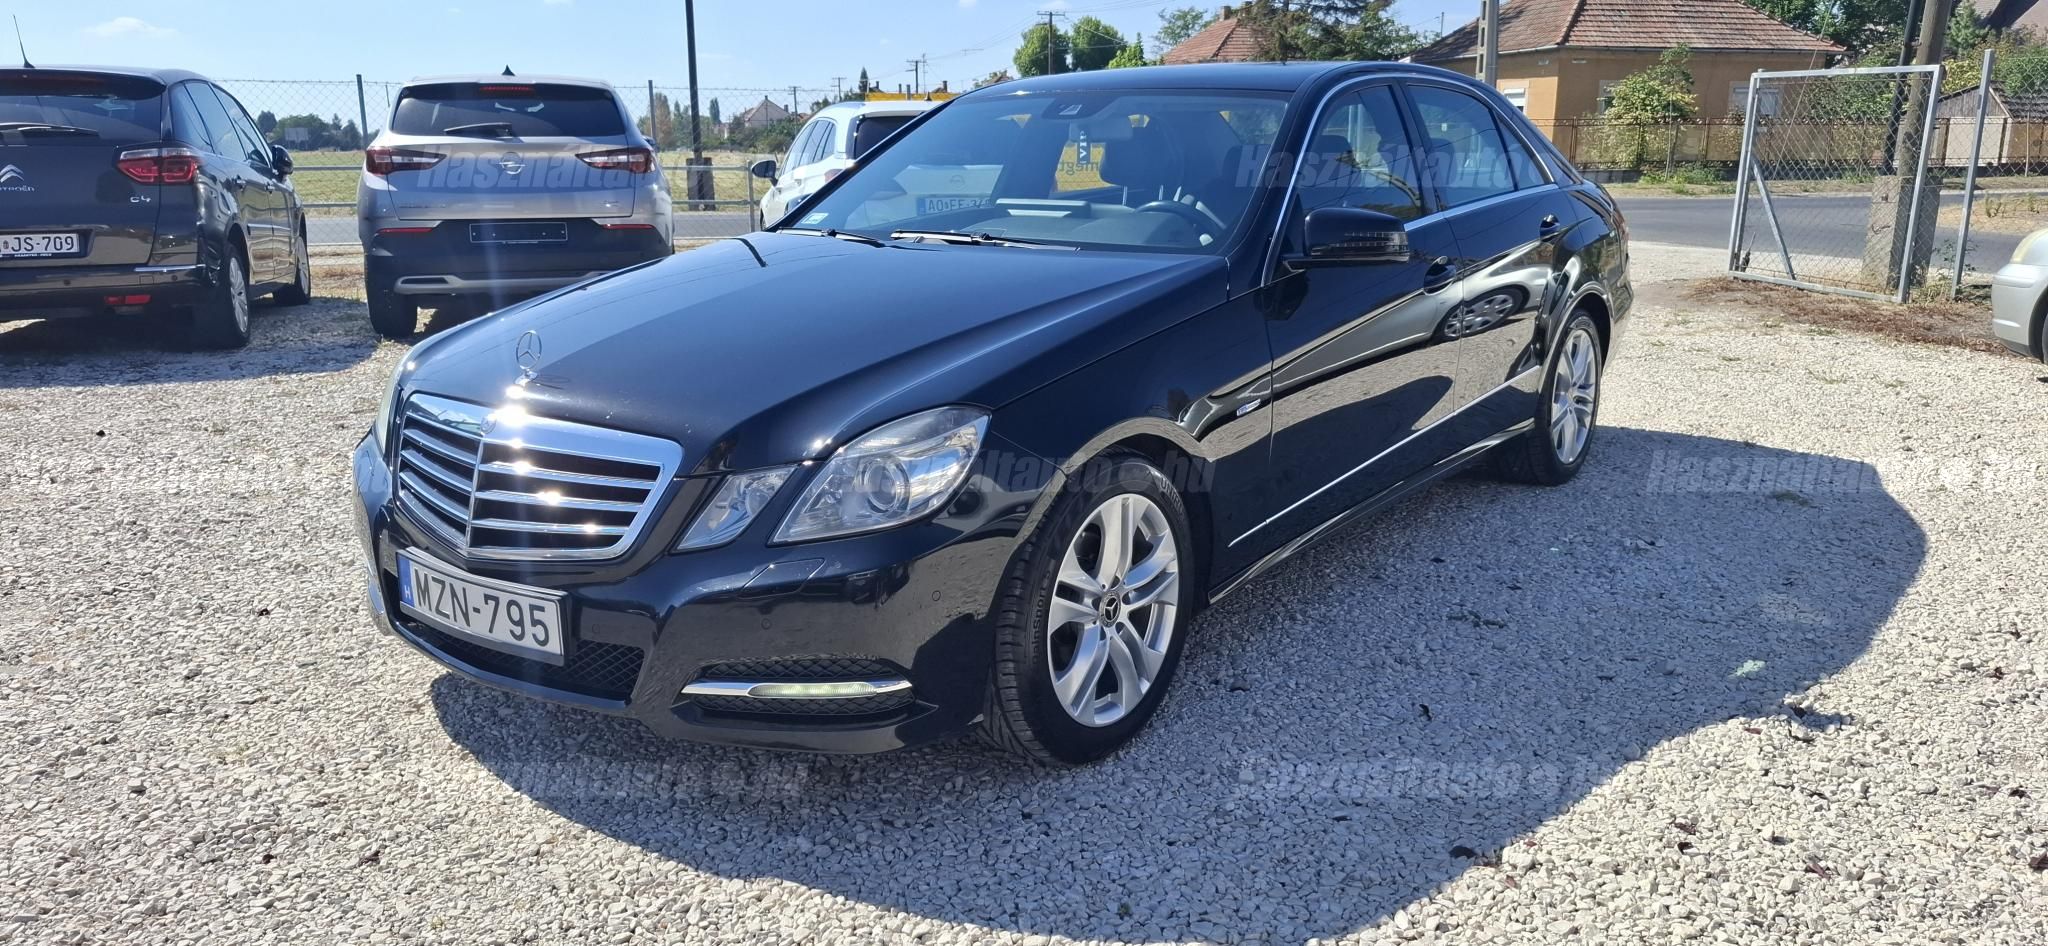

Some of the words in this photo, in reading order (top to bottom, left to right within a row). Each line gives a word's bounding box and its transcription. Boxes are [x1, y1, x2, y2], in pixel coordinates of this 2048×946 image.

[130, 195, 152, 203] C4
[11, 236, 75, 252] JS-709
[404, 585, 412, 598] H
[413, 568, 550, 648] MZN-795
